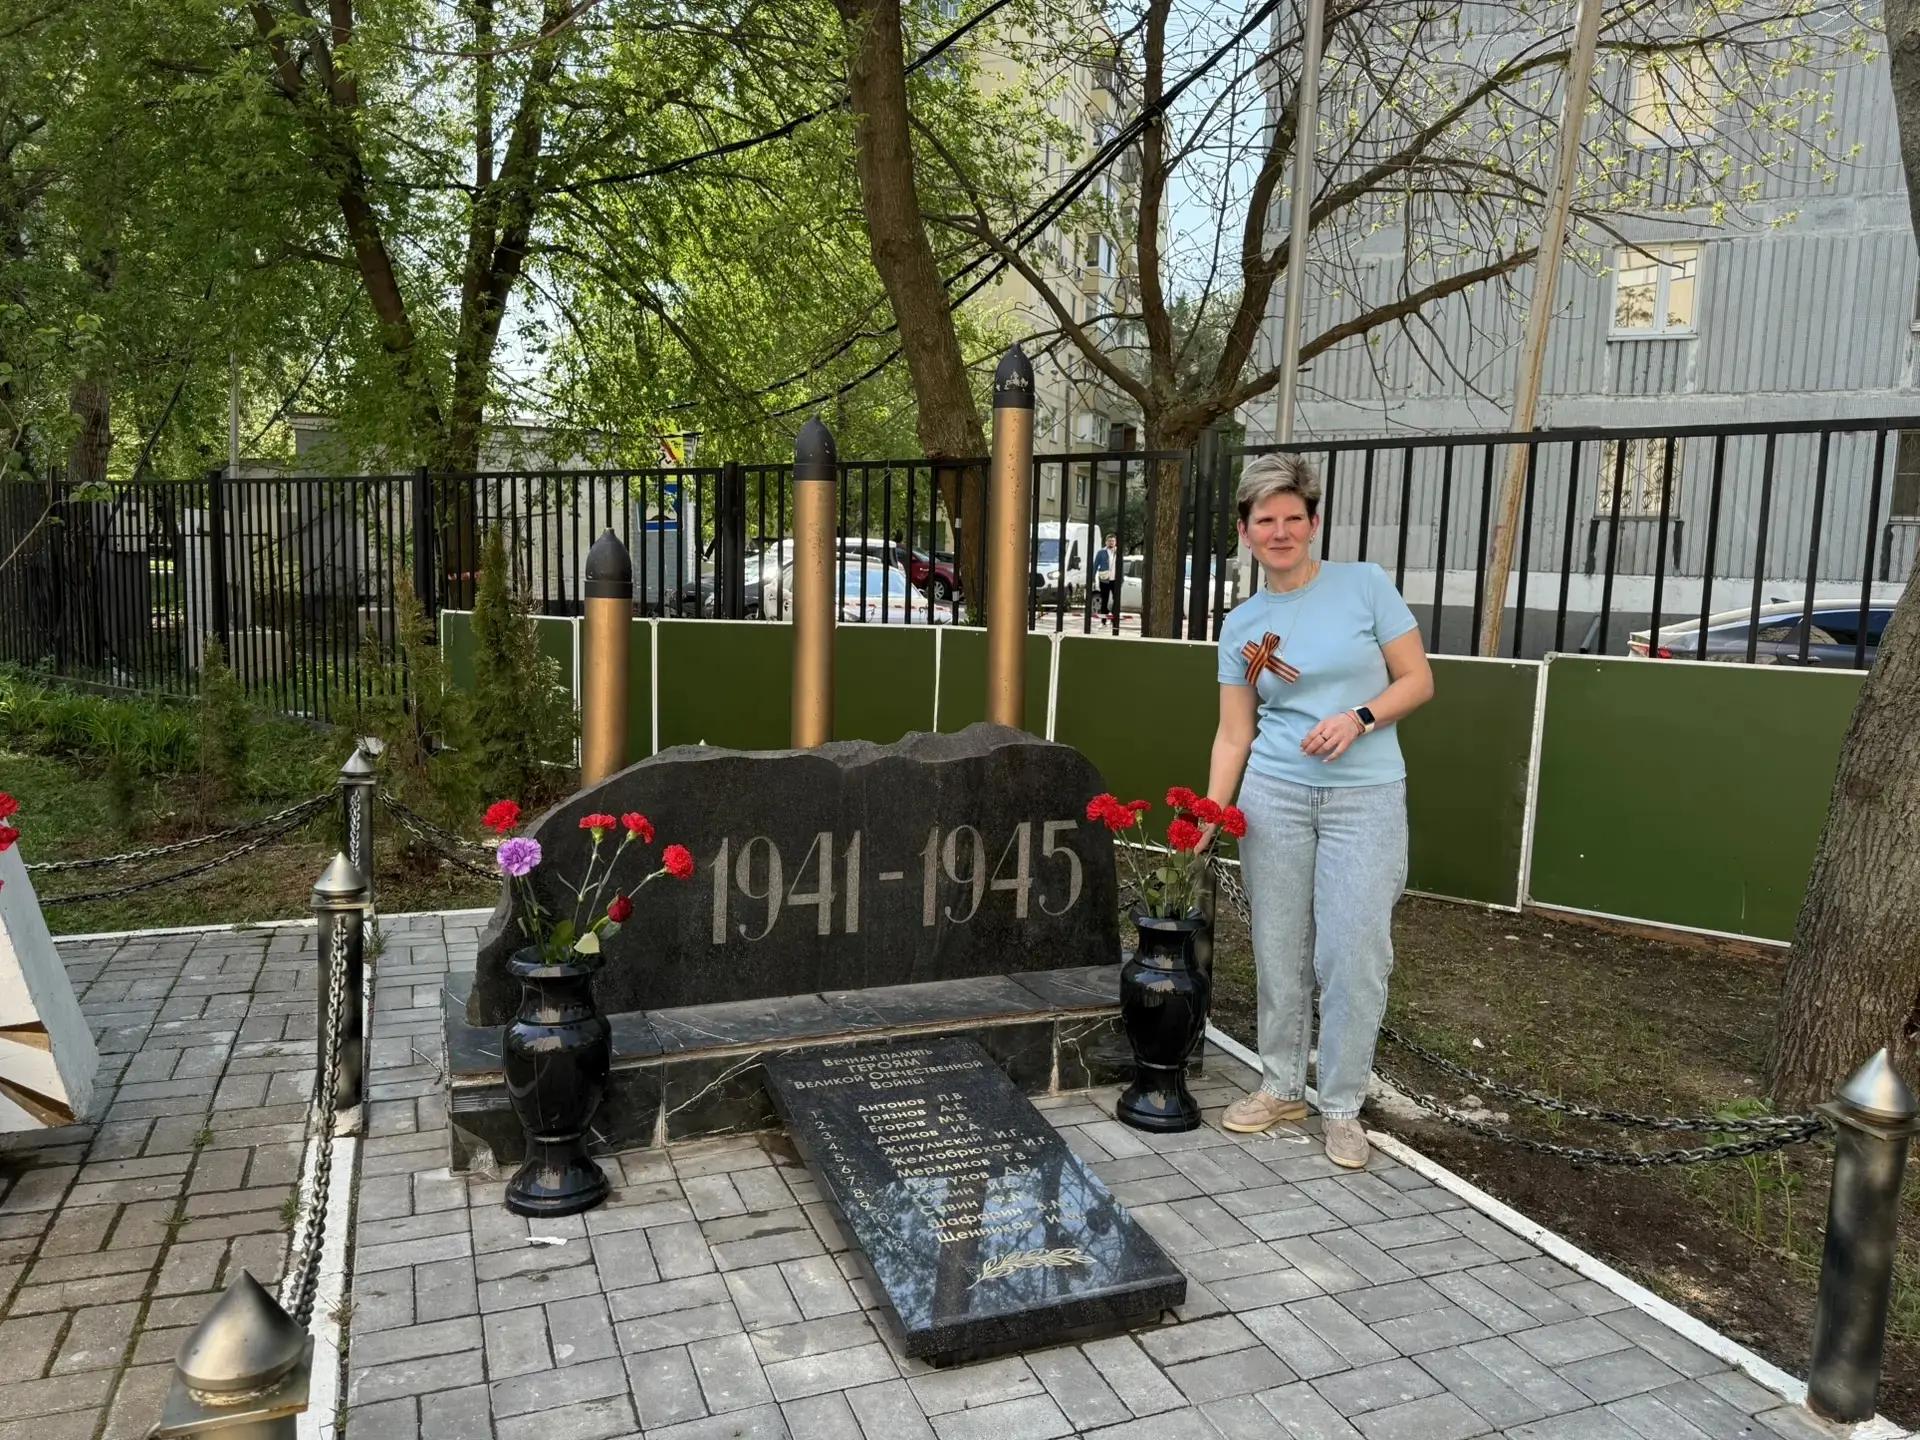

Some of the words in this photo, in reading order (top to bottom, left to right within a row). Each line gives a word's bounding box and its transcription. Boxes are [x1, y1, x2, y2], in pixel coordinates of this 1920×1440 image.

[848, 1058, 920, 1074] ГЕРОЯМ
[811, 1111, 824, 1119] 1.
[857, 1099, 926, 1112] Антонов
[937, 1092, 967, 1102] П.В.
[815, 1121, 831, 1129] 2.
[862, 1109, 927, 1124] Грязнов
[940, 1103, 968, 1113] А.Г.
[821, 1131, 837, 1140] 3.
[868, 1120, 927, 1134] Егоров
[938, 1113, 972, 1124] М.В.
[828, 1142, 843, 1150] 4.
[877, 1129, 939, 1145] Данков
[951, 1122, 985, 1133] И.А.
[834, 1153, 850, 1162] 5.
[882, 1135, 983, 1155] Жигульский
[994, 1128, 1024, 1139] И.Г.
[841, 1165, 856, 1173] 6.
[889, 1142, 1012, 1167] Желтобрюхов
[1023, 1136, 1053, 1147] И.Г.
[846, 1176, 863, 1186] 7.
[896, 1158, 991, 1178] Мерзляков
[853, 1188, 870, 1198] 8.
[936, 1220, 1033, 1243] Щенников
